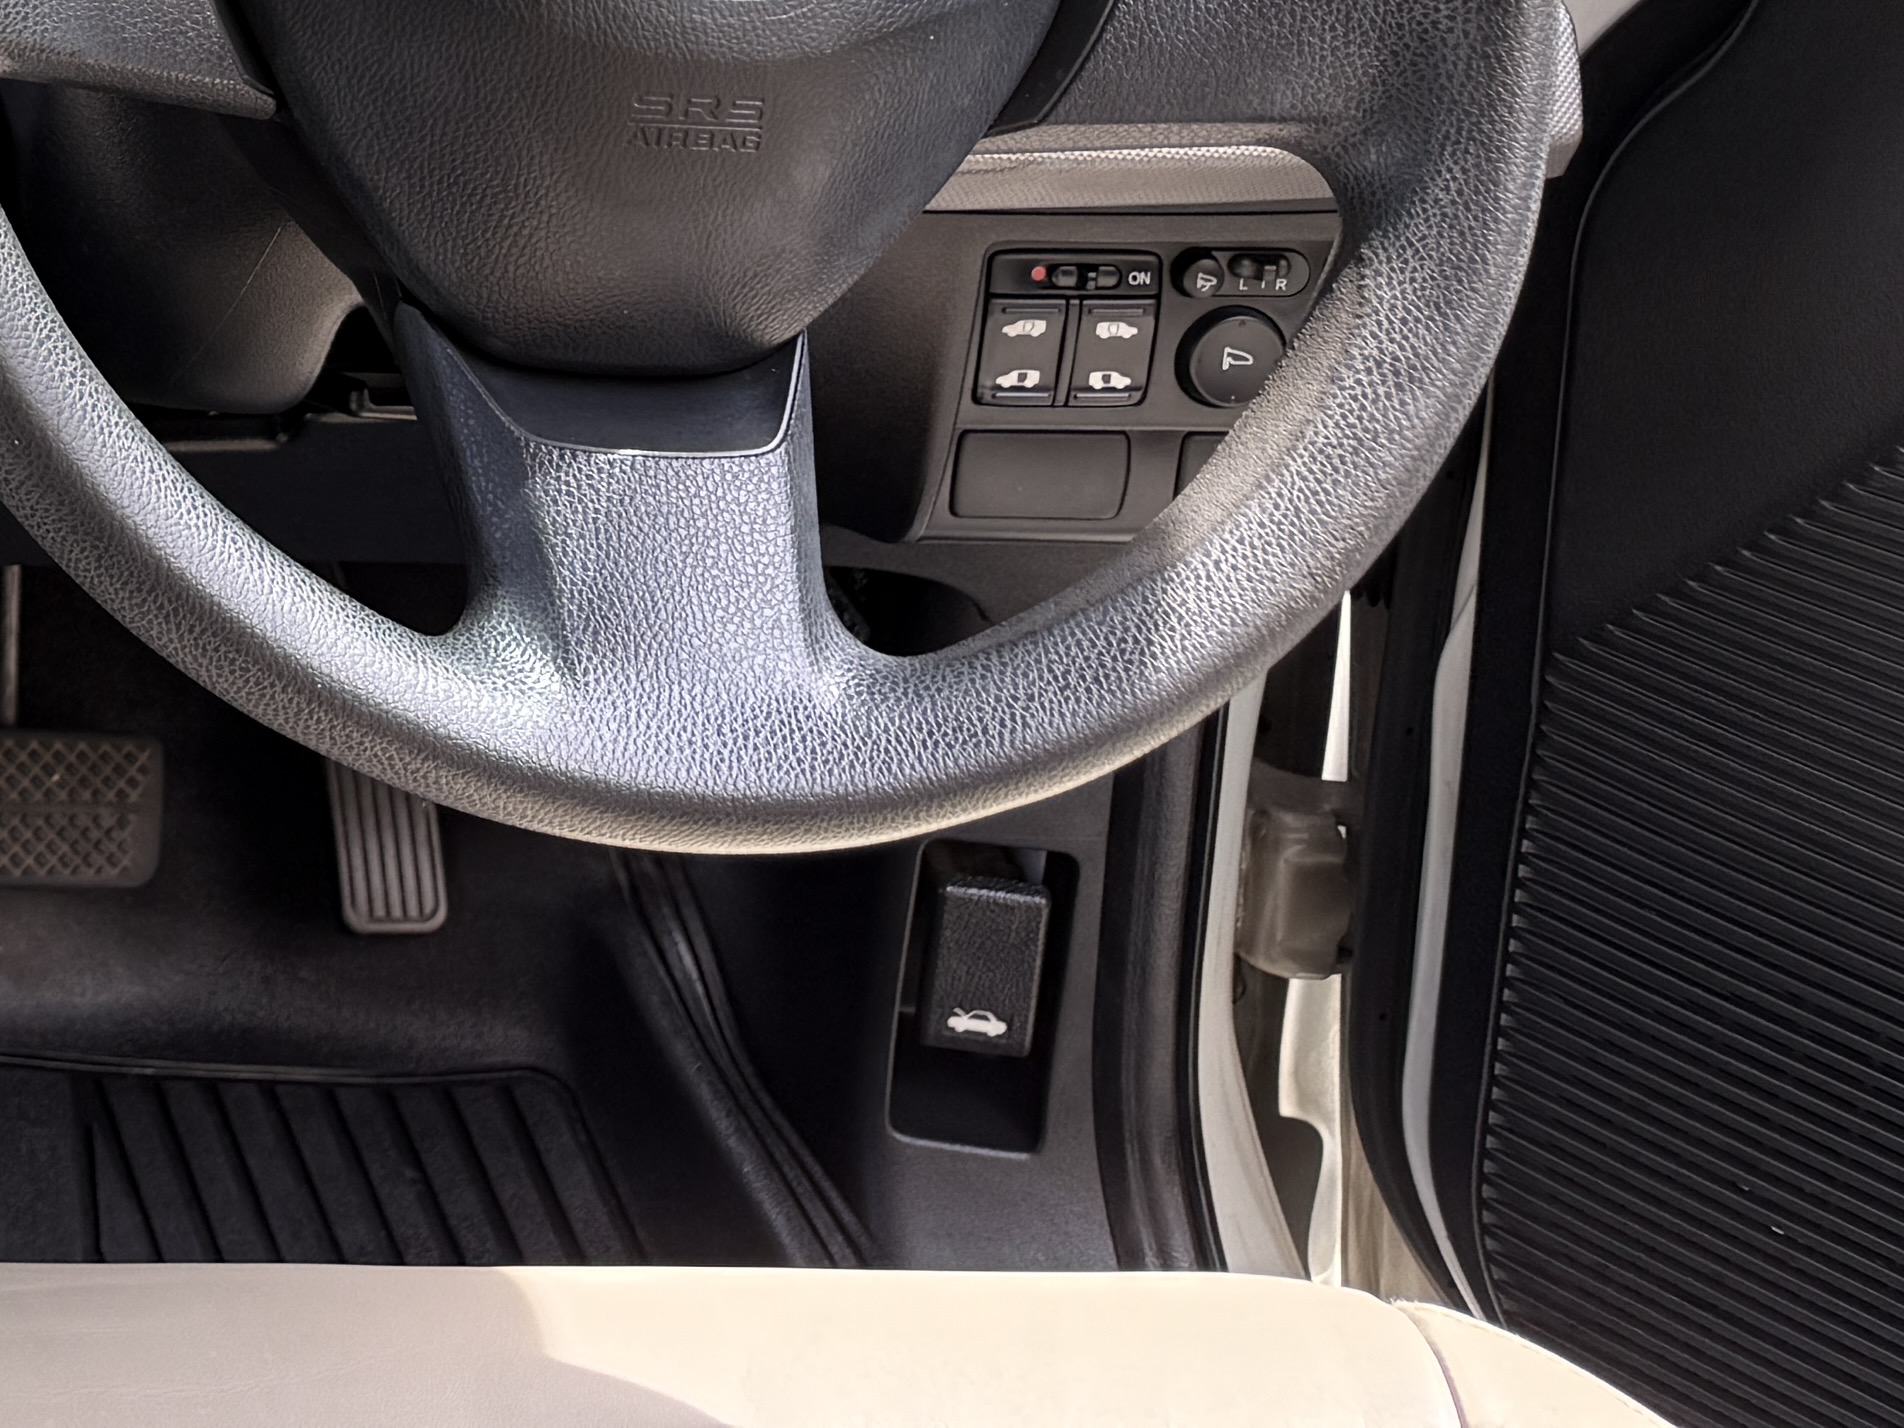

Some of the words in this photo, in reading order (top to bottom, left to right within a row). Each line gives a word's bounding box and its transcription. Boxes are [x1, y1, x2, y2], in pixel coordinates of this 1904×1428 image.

[631, 94, 765, 122] SRS
[623, 127, 763, 153] AIRBAG
[1128, 271, 1151, 286] ON
[1239, 279, 1248, 291] L
[1276, 279, 1287, 291] R
